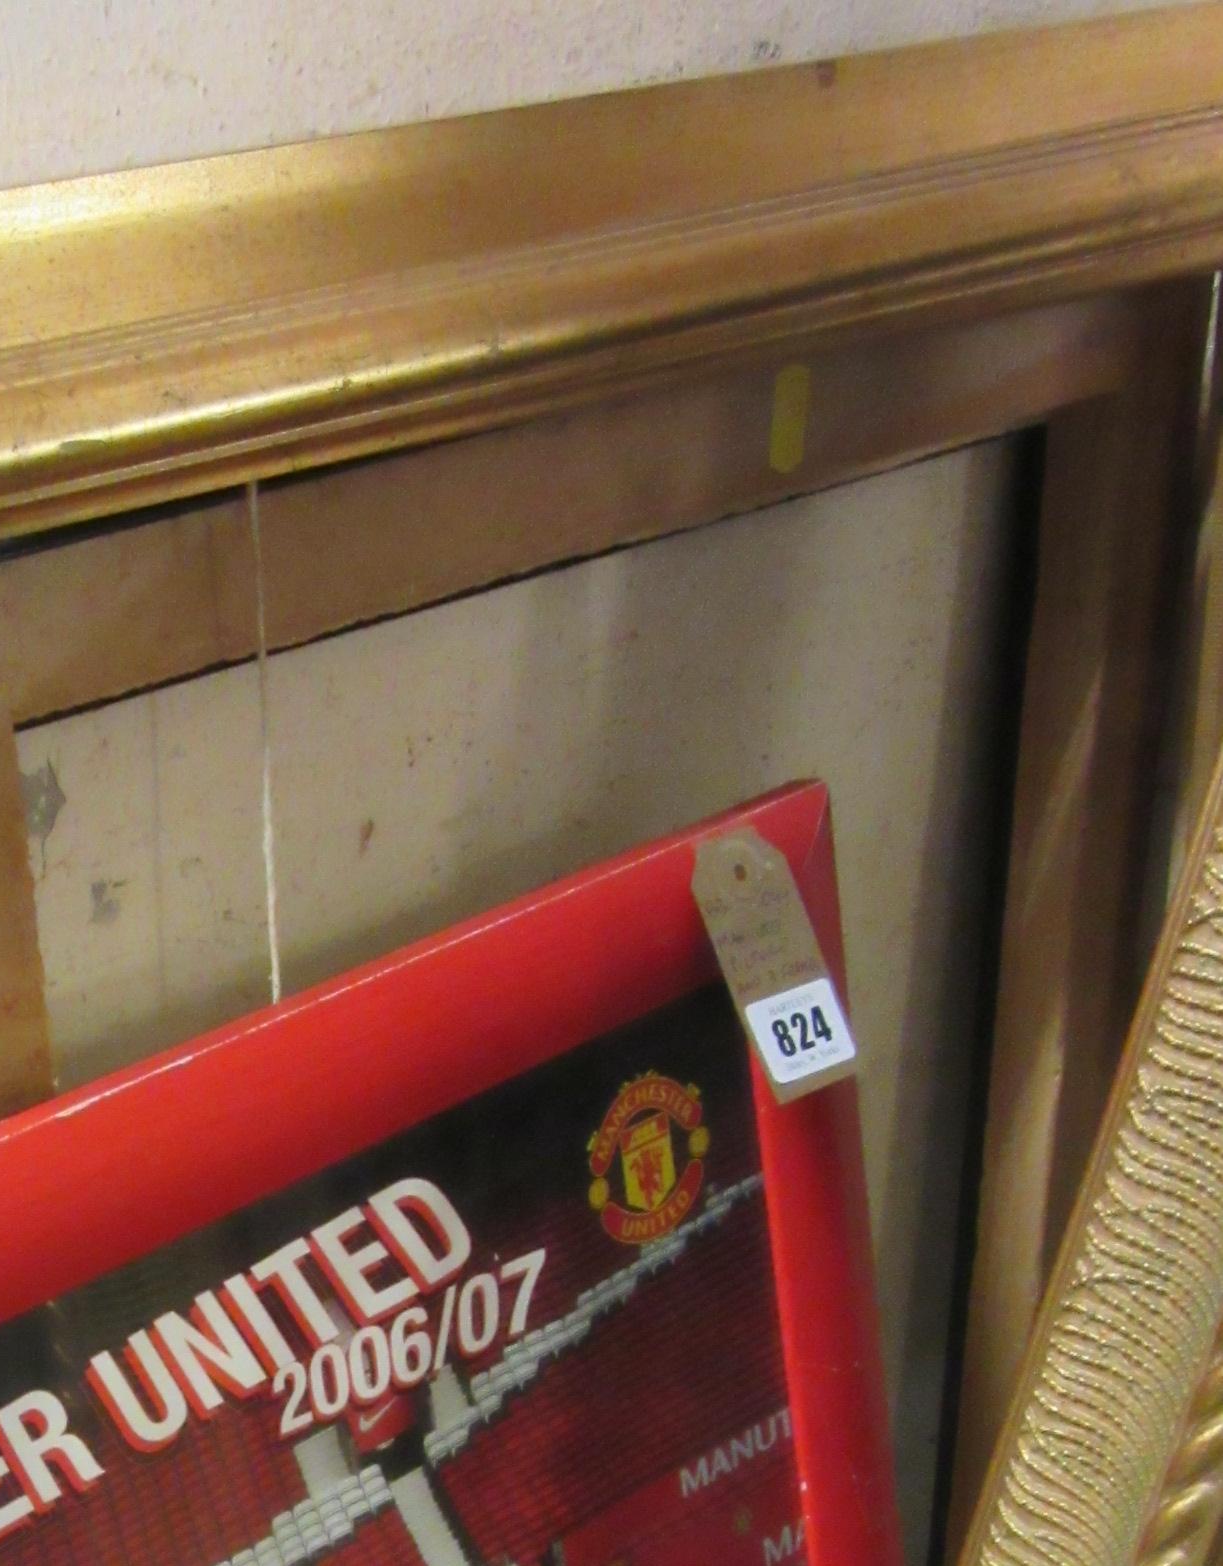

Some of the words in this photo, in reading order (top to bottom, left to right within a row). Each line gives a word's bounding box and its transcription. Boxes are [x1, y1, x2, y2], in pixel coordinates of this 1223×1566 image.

[771, 1005, 833, 1057] 824
[598, 1084, 693, 1161] MANCHESTER
[621, 1190, 689, 1236] UNITED
[86, 1177, 473, 1455] UNITED
[272, 1247, 547, 1440] 2006/07
